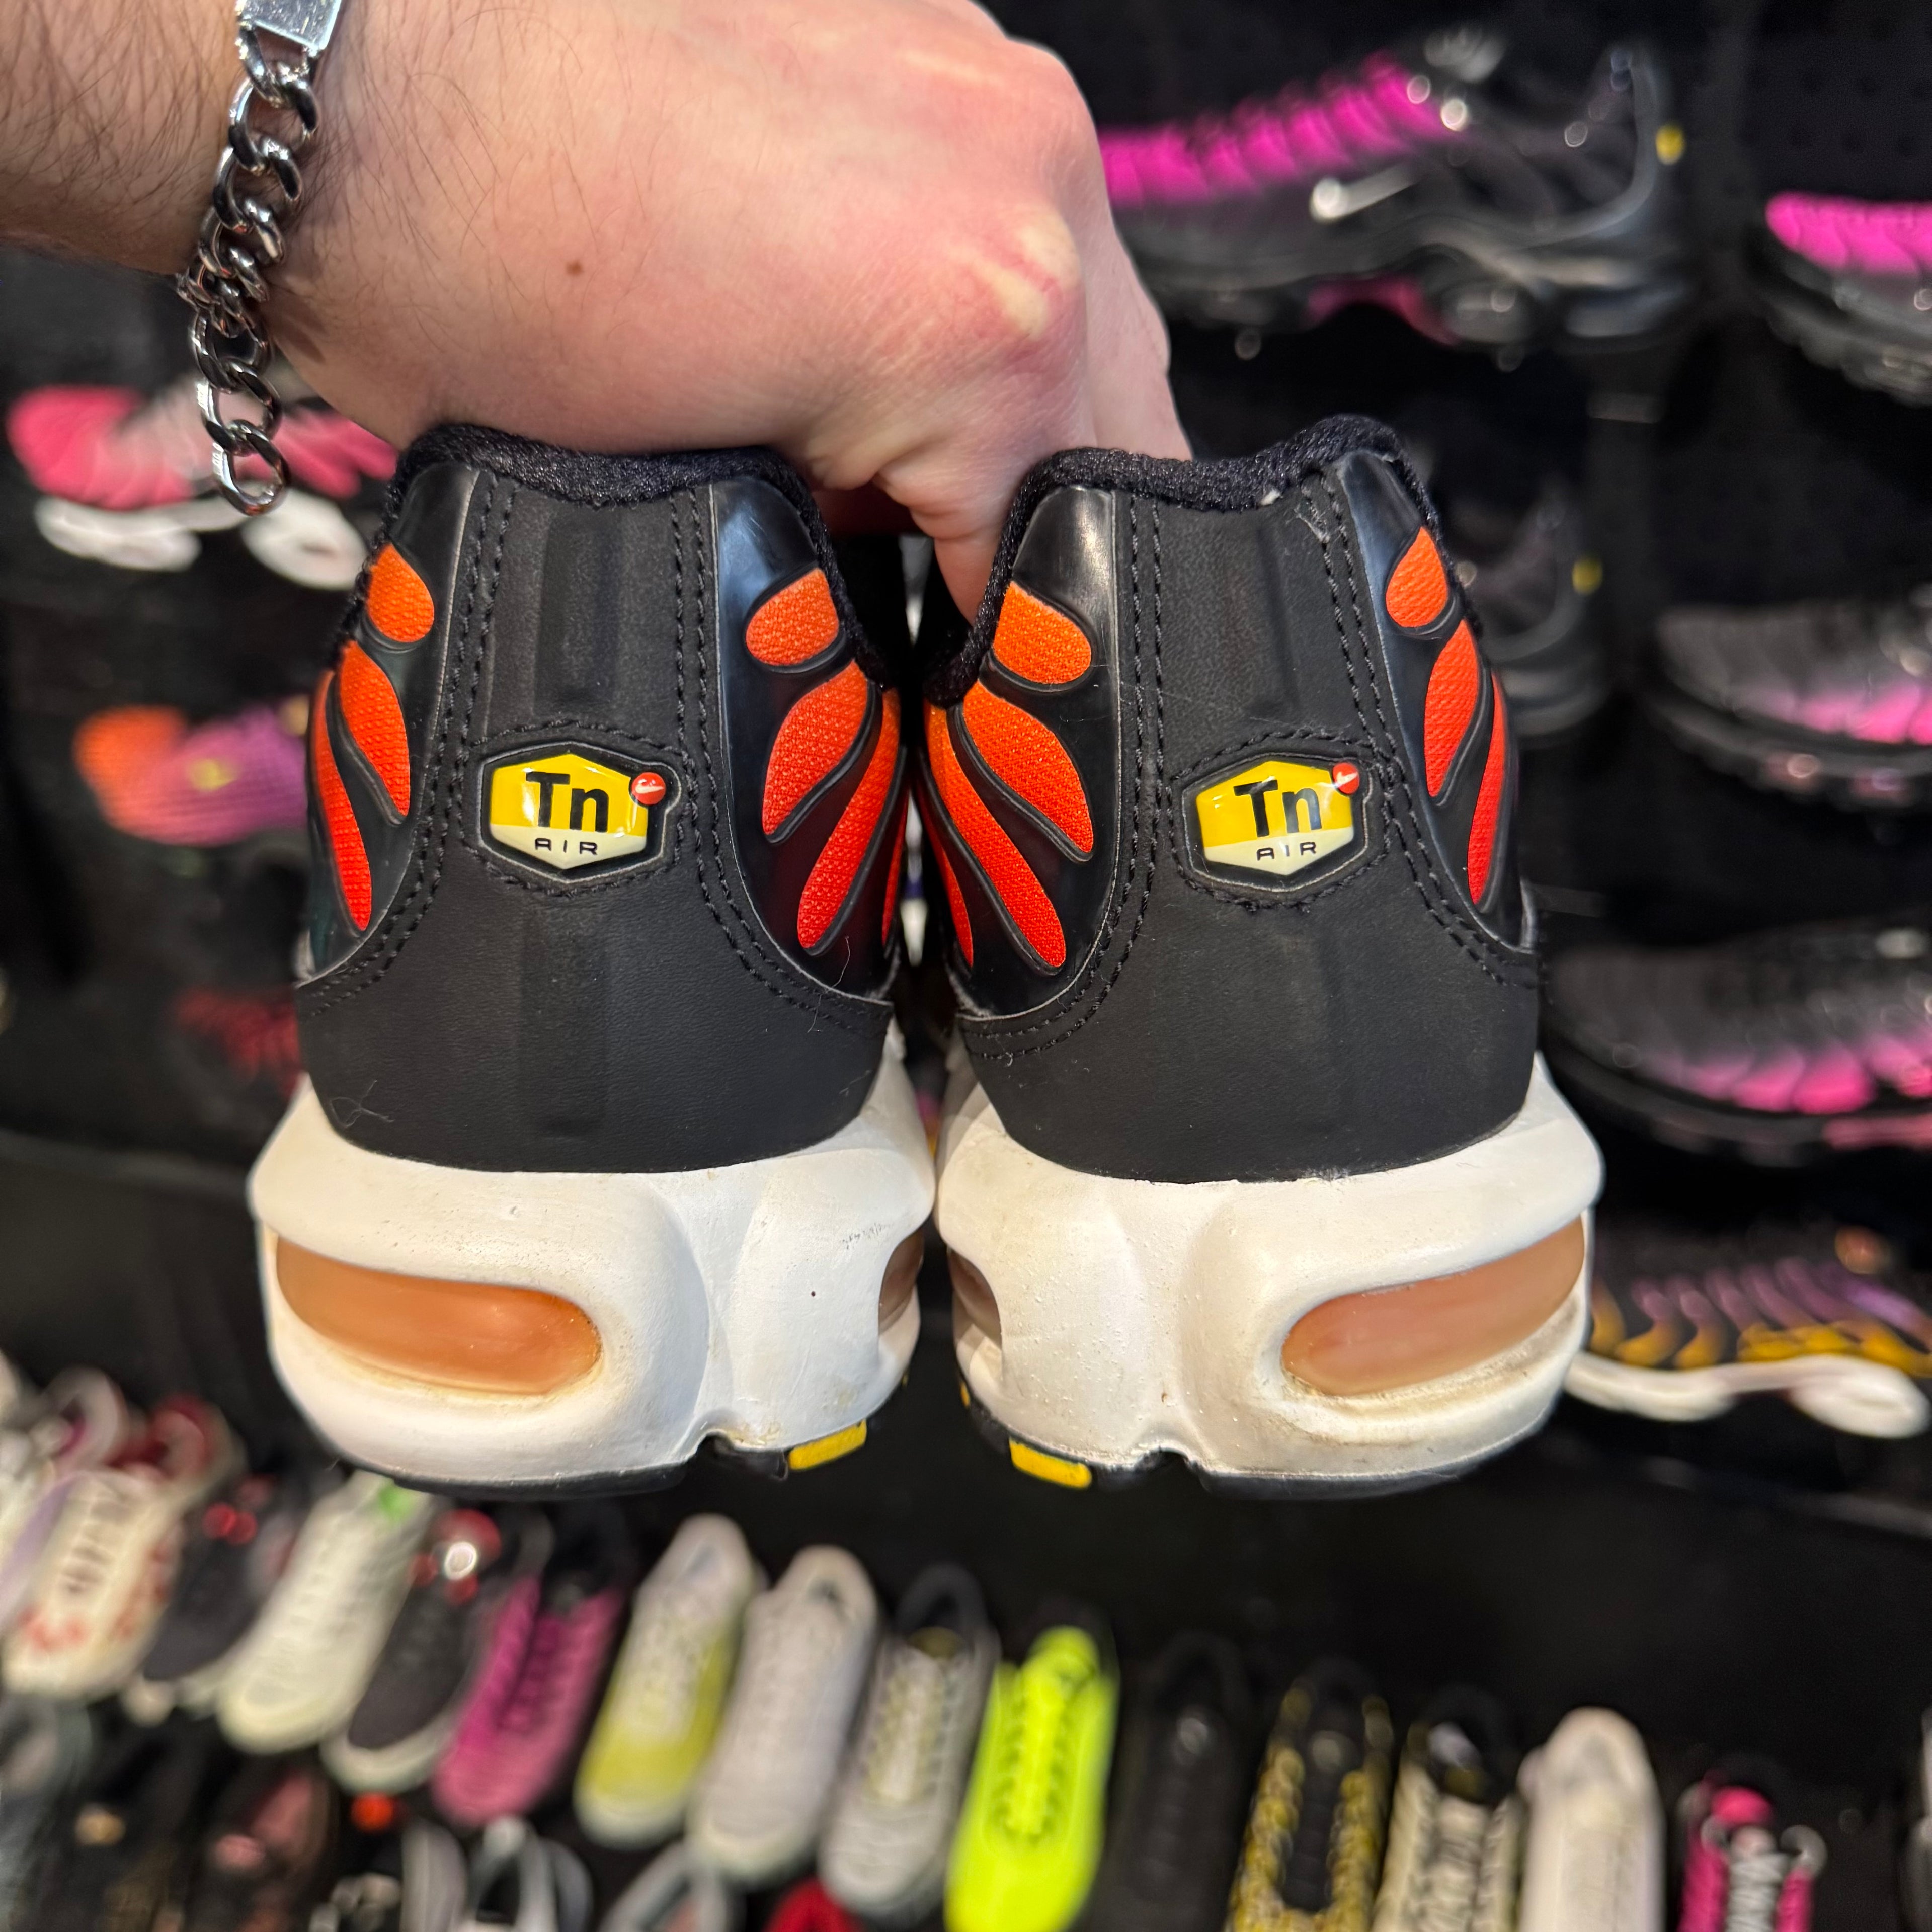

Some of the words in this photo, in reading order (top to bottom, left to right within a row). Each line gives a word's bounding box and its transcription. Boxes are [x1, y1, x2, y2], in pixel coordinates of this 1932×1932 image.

[526, 771, 609, 832] Tn
[1233, 780, 1322, 837] Tn
[535, 838, 598, 855] AIR
[1256, 841, 1317, 861] AIR
